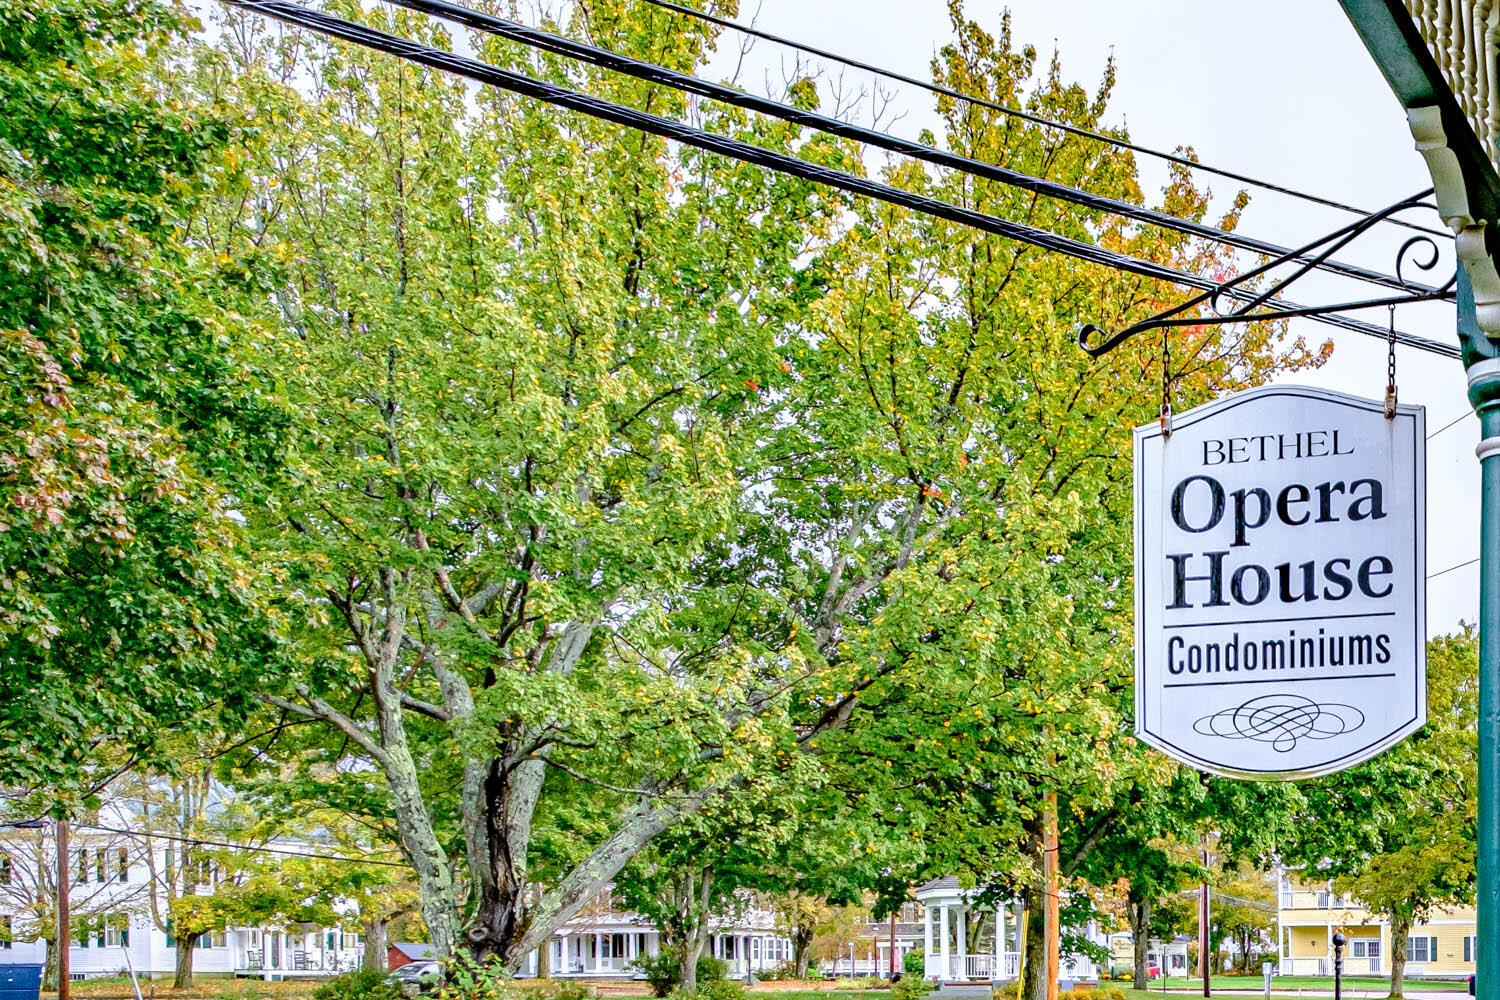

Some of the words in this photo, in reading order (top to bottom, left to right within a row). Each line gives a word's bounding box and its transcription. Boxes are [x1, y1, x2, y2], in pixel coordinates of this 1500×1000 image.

[1202, 430, 1355, 466] BETHEL
[1170, 474, 1388, 548] Opera
[1165, 550, 1394, 611] House
[1168, 628, 1391, 675] Condominiums
